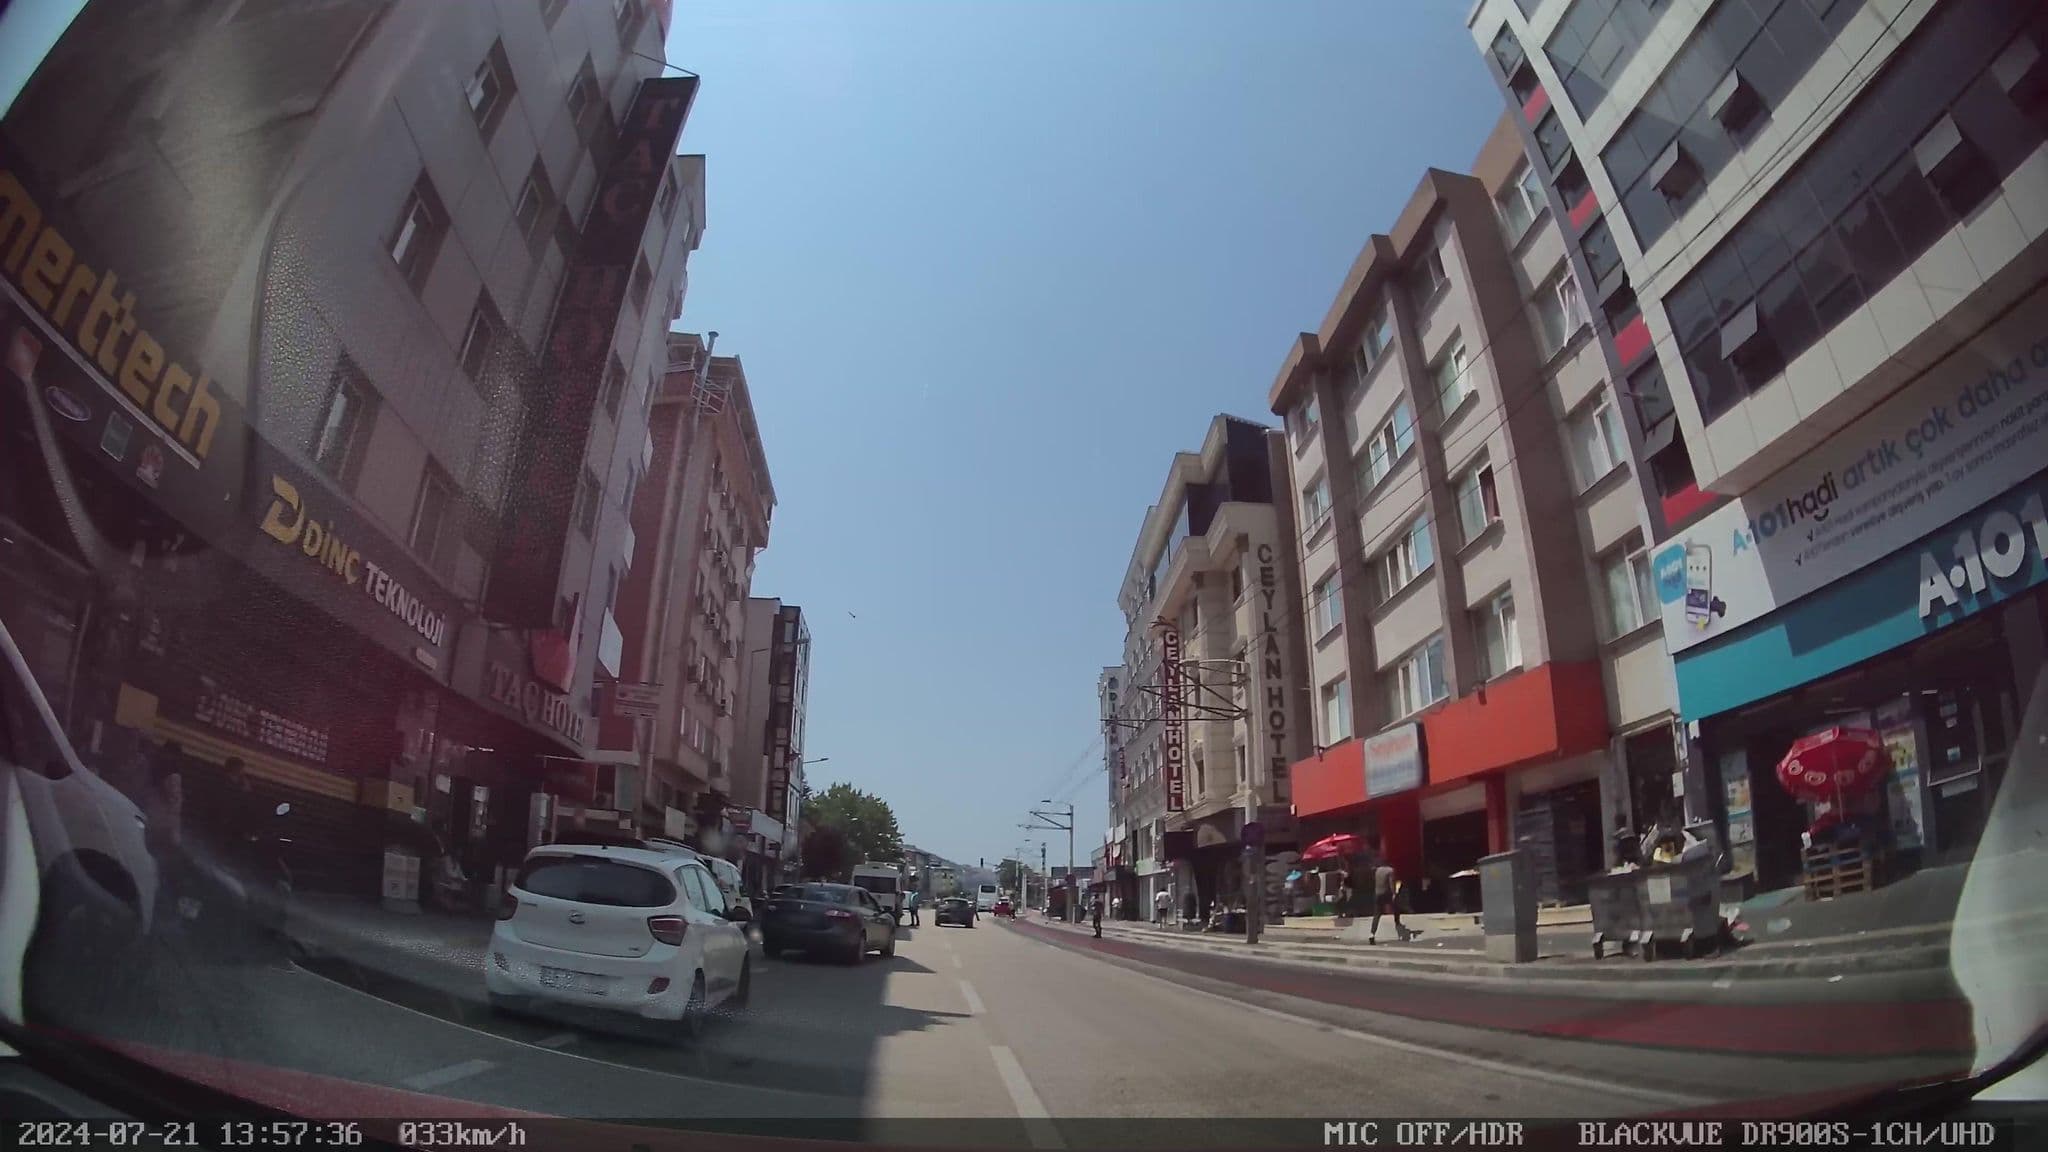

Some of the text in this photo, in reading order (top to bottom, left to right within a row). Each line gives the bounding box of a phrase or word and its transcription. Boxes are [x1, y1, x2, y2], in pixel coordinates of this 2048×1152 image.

[1843, 439, 1902, 490] artık
[1905, 406, 1954, 459] çok
[1958, 357, 2028, 419] daha
[1164, 631, 1183, 811] CEYLAN HOTEL
[1257, 543, 1289, 804] CEYLAN HOTEL
